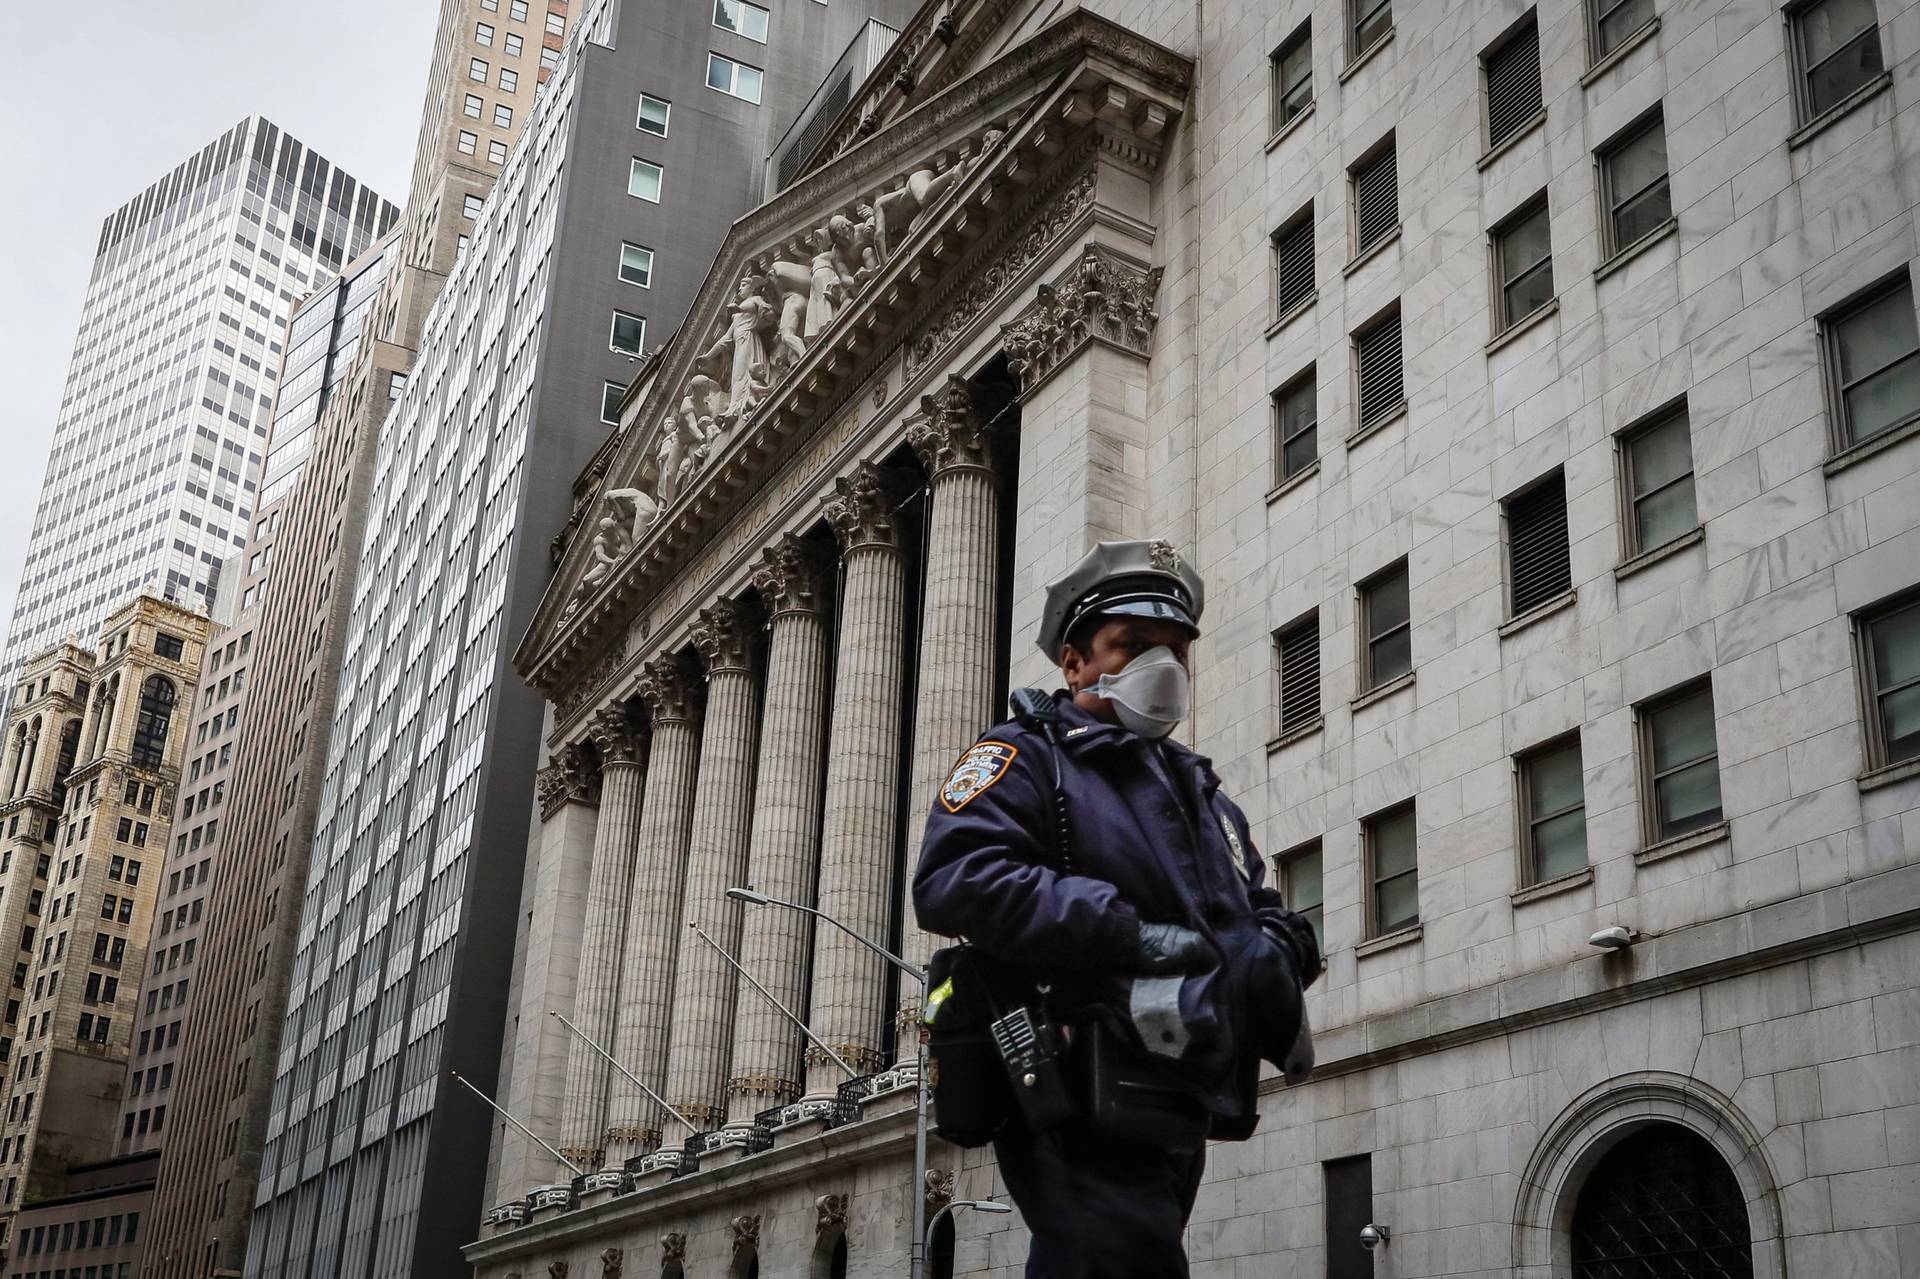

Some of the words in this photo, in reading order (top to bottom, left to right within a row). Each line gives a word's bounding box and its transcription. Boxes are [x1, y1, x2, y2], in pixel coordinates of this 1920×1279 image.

[690, 546, 722, 592] YORK
[730, 498, 771, 553] STOCK
[779, 405, 860, 505] EXCHANGE
